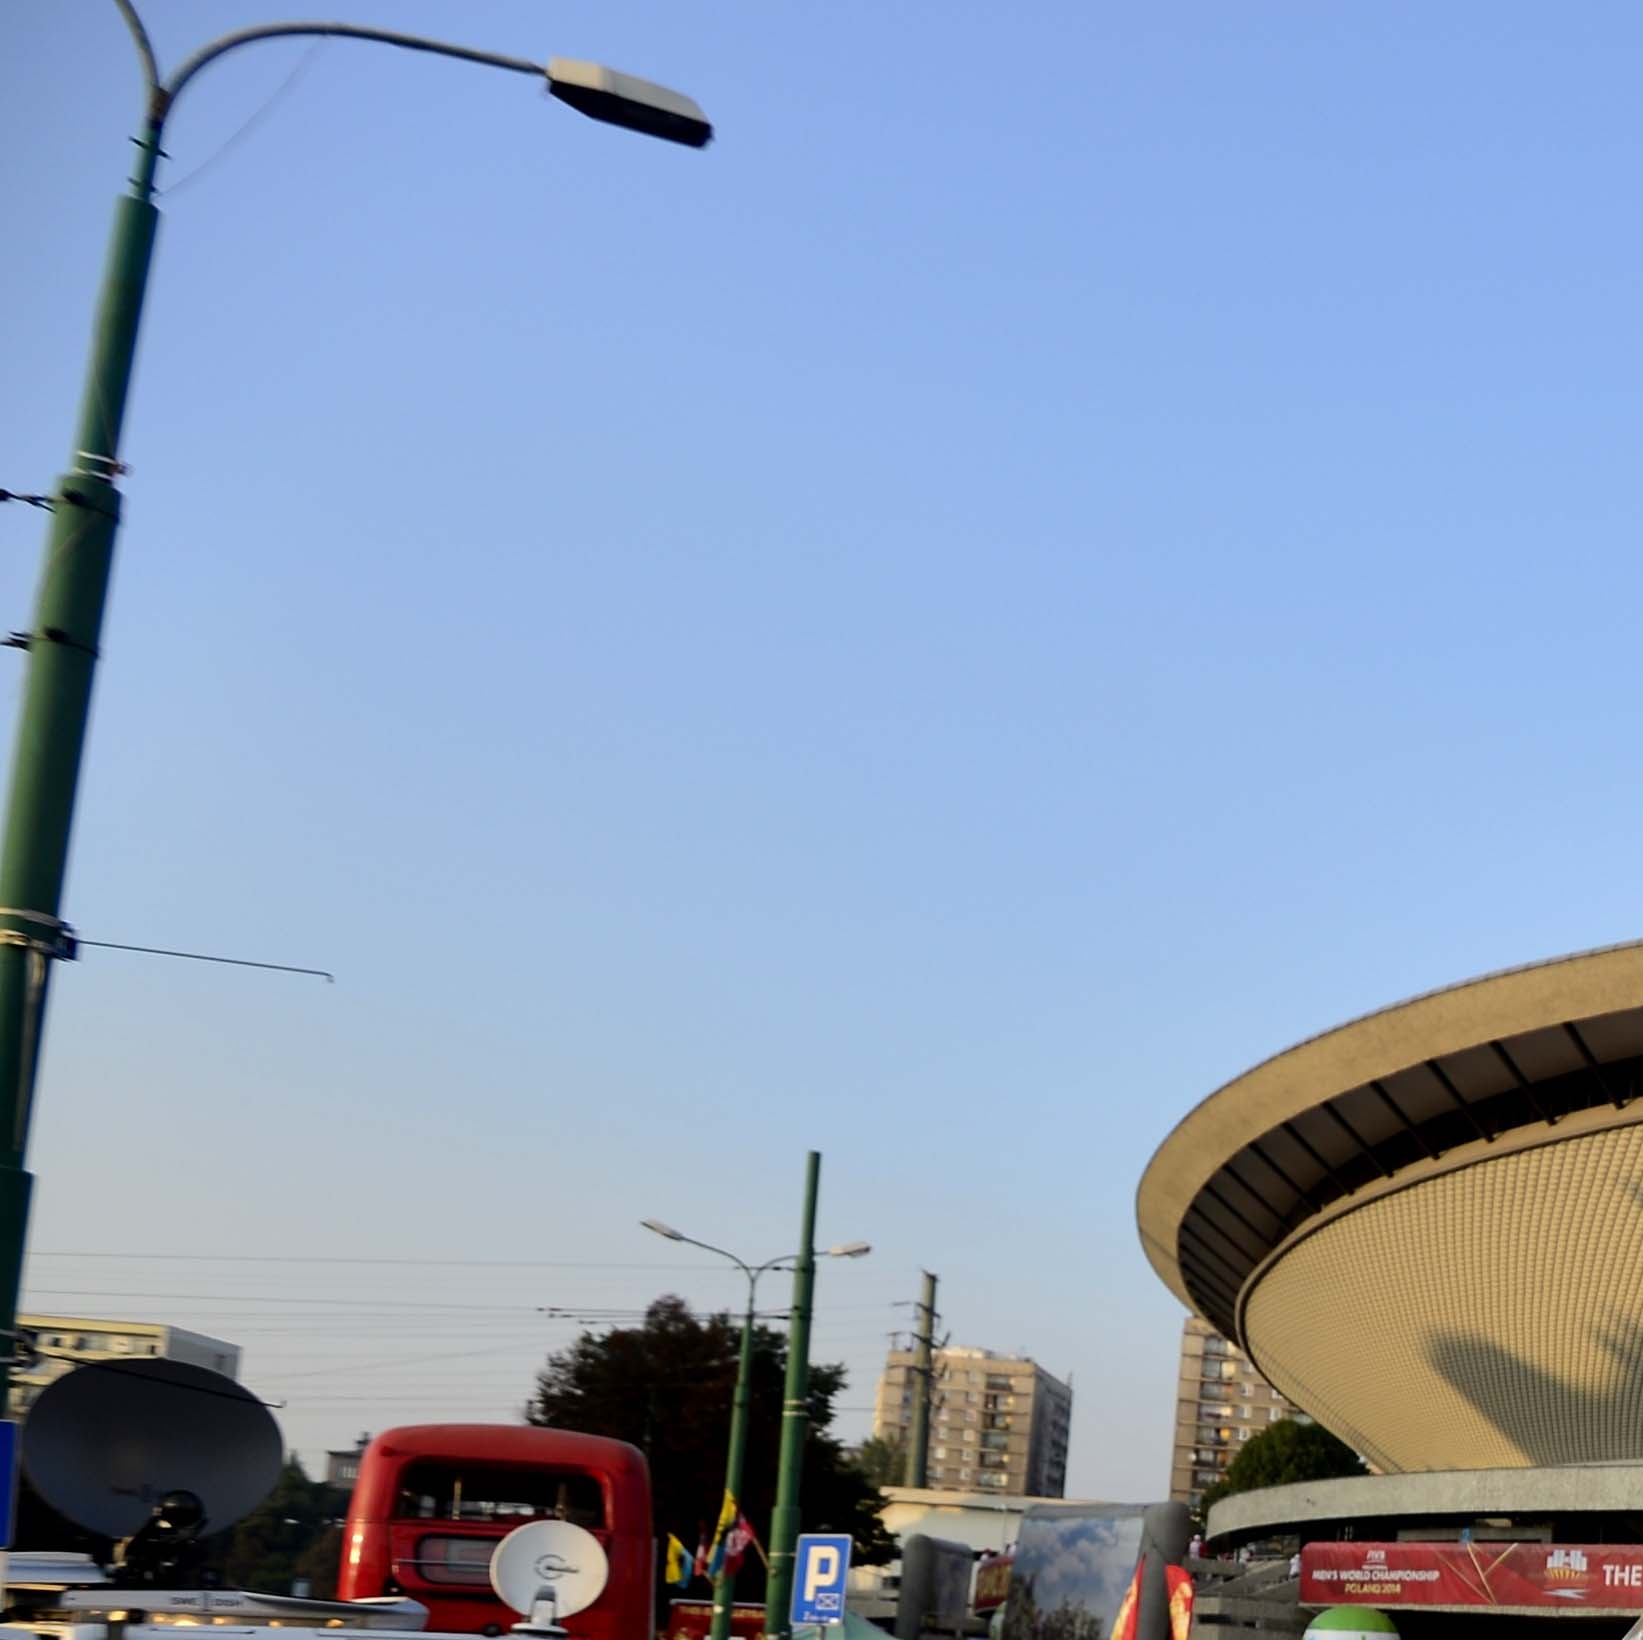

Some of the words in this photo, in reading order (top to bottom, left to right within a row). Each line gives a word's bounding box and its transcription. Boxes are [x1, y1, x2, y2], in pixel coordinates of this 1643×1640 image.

[804, 1546, 839, 1601] P
[1339, 1570, 1370, 1581] WORLD
[1372, 1570, 1440, 1582] CHAMPIONSHIP
[1603, 1564, 1642, 1587] THE
[1345, 1583, 1381, 1594] POLAND
